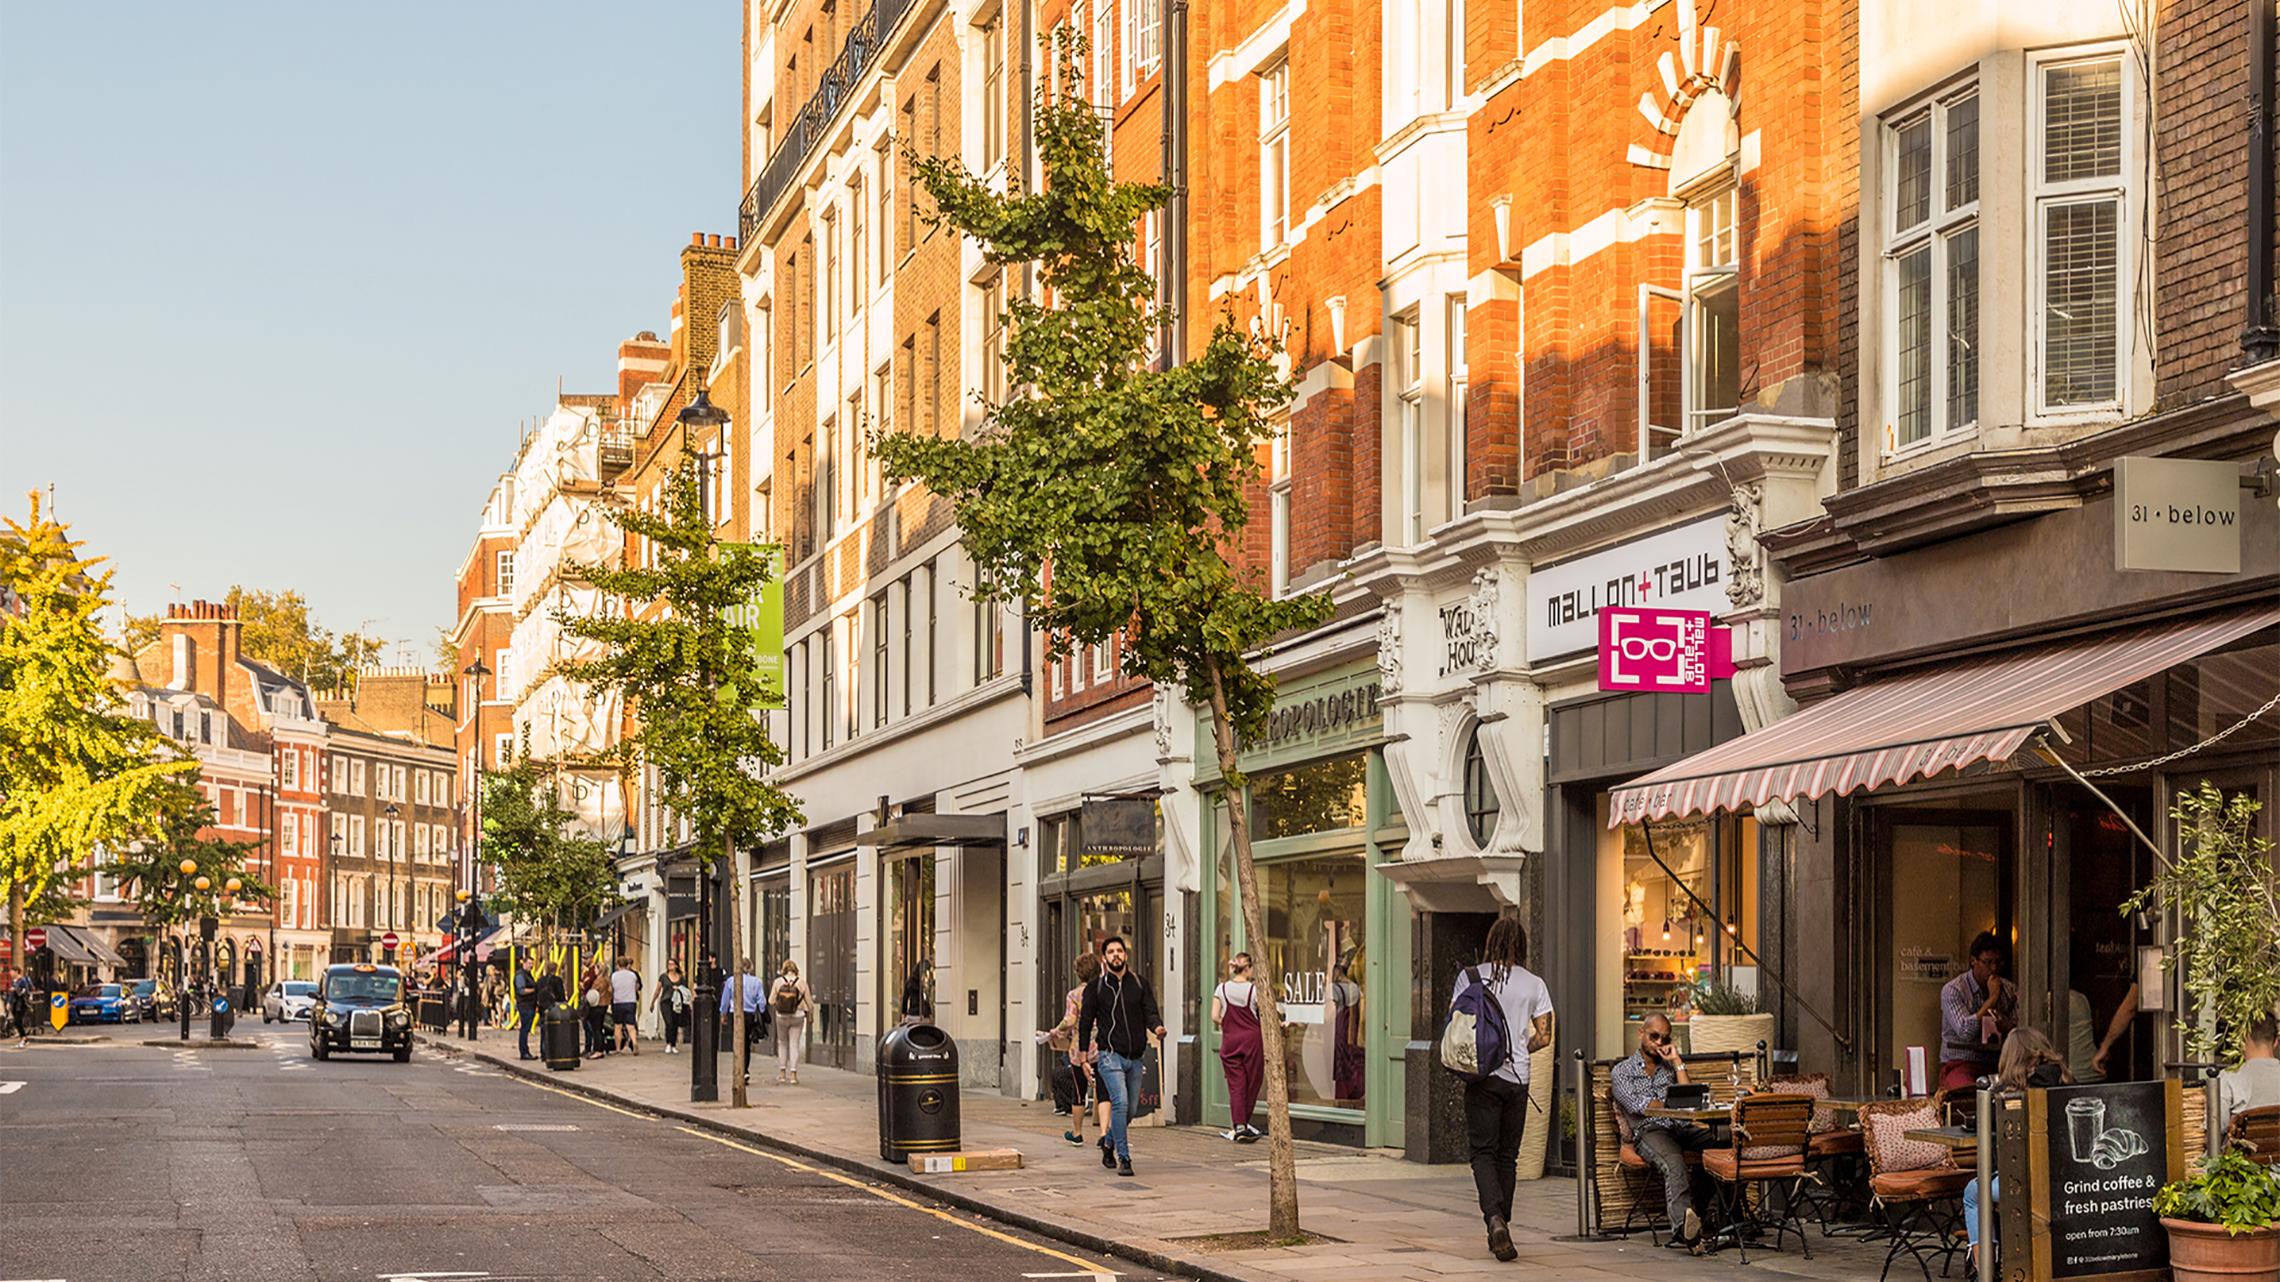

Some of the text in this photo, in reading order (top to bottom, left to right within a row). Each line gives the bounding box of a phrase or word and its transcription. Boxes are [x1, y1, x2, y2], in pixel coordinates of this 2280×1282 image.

[2132, 504, 2235, 525] 31 below
[1791, 601, 1873, 640] 31 below
[1447, 640, 1476, 673] HOU
[1284, 971, 1326, 1003] SALE
[2064, 1174, 2155, 1194] Grind coffee &
[2064, 1196, 2153, 1215] fresh pastries
[2065, 1231, 2087, 1241] open
[2087, 1228, 2108, 1238] from
